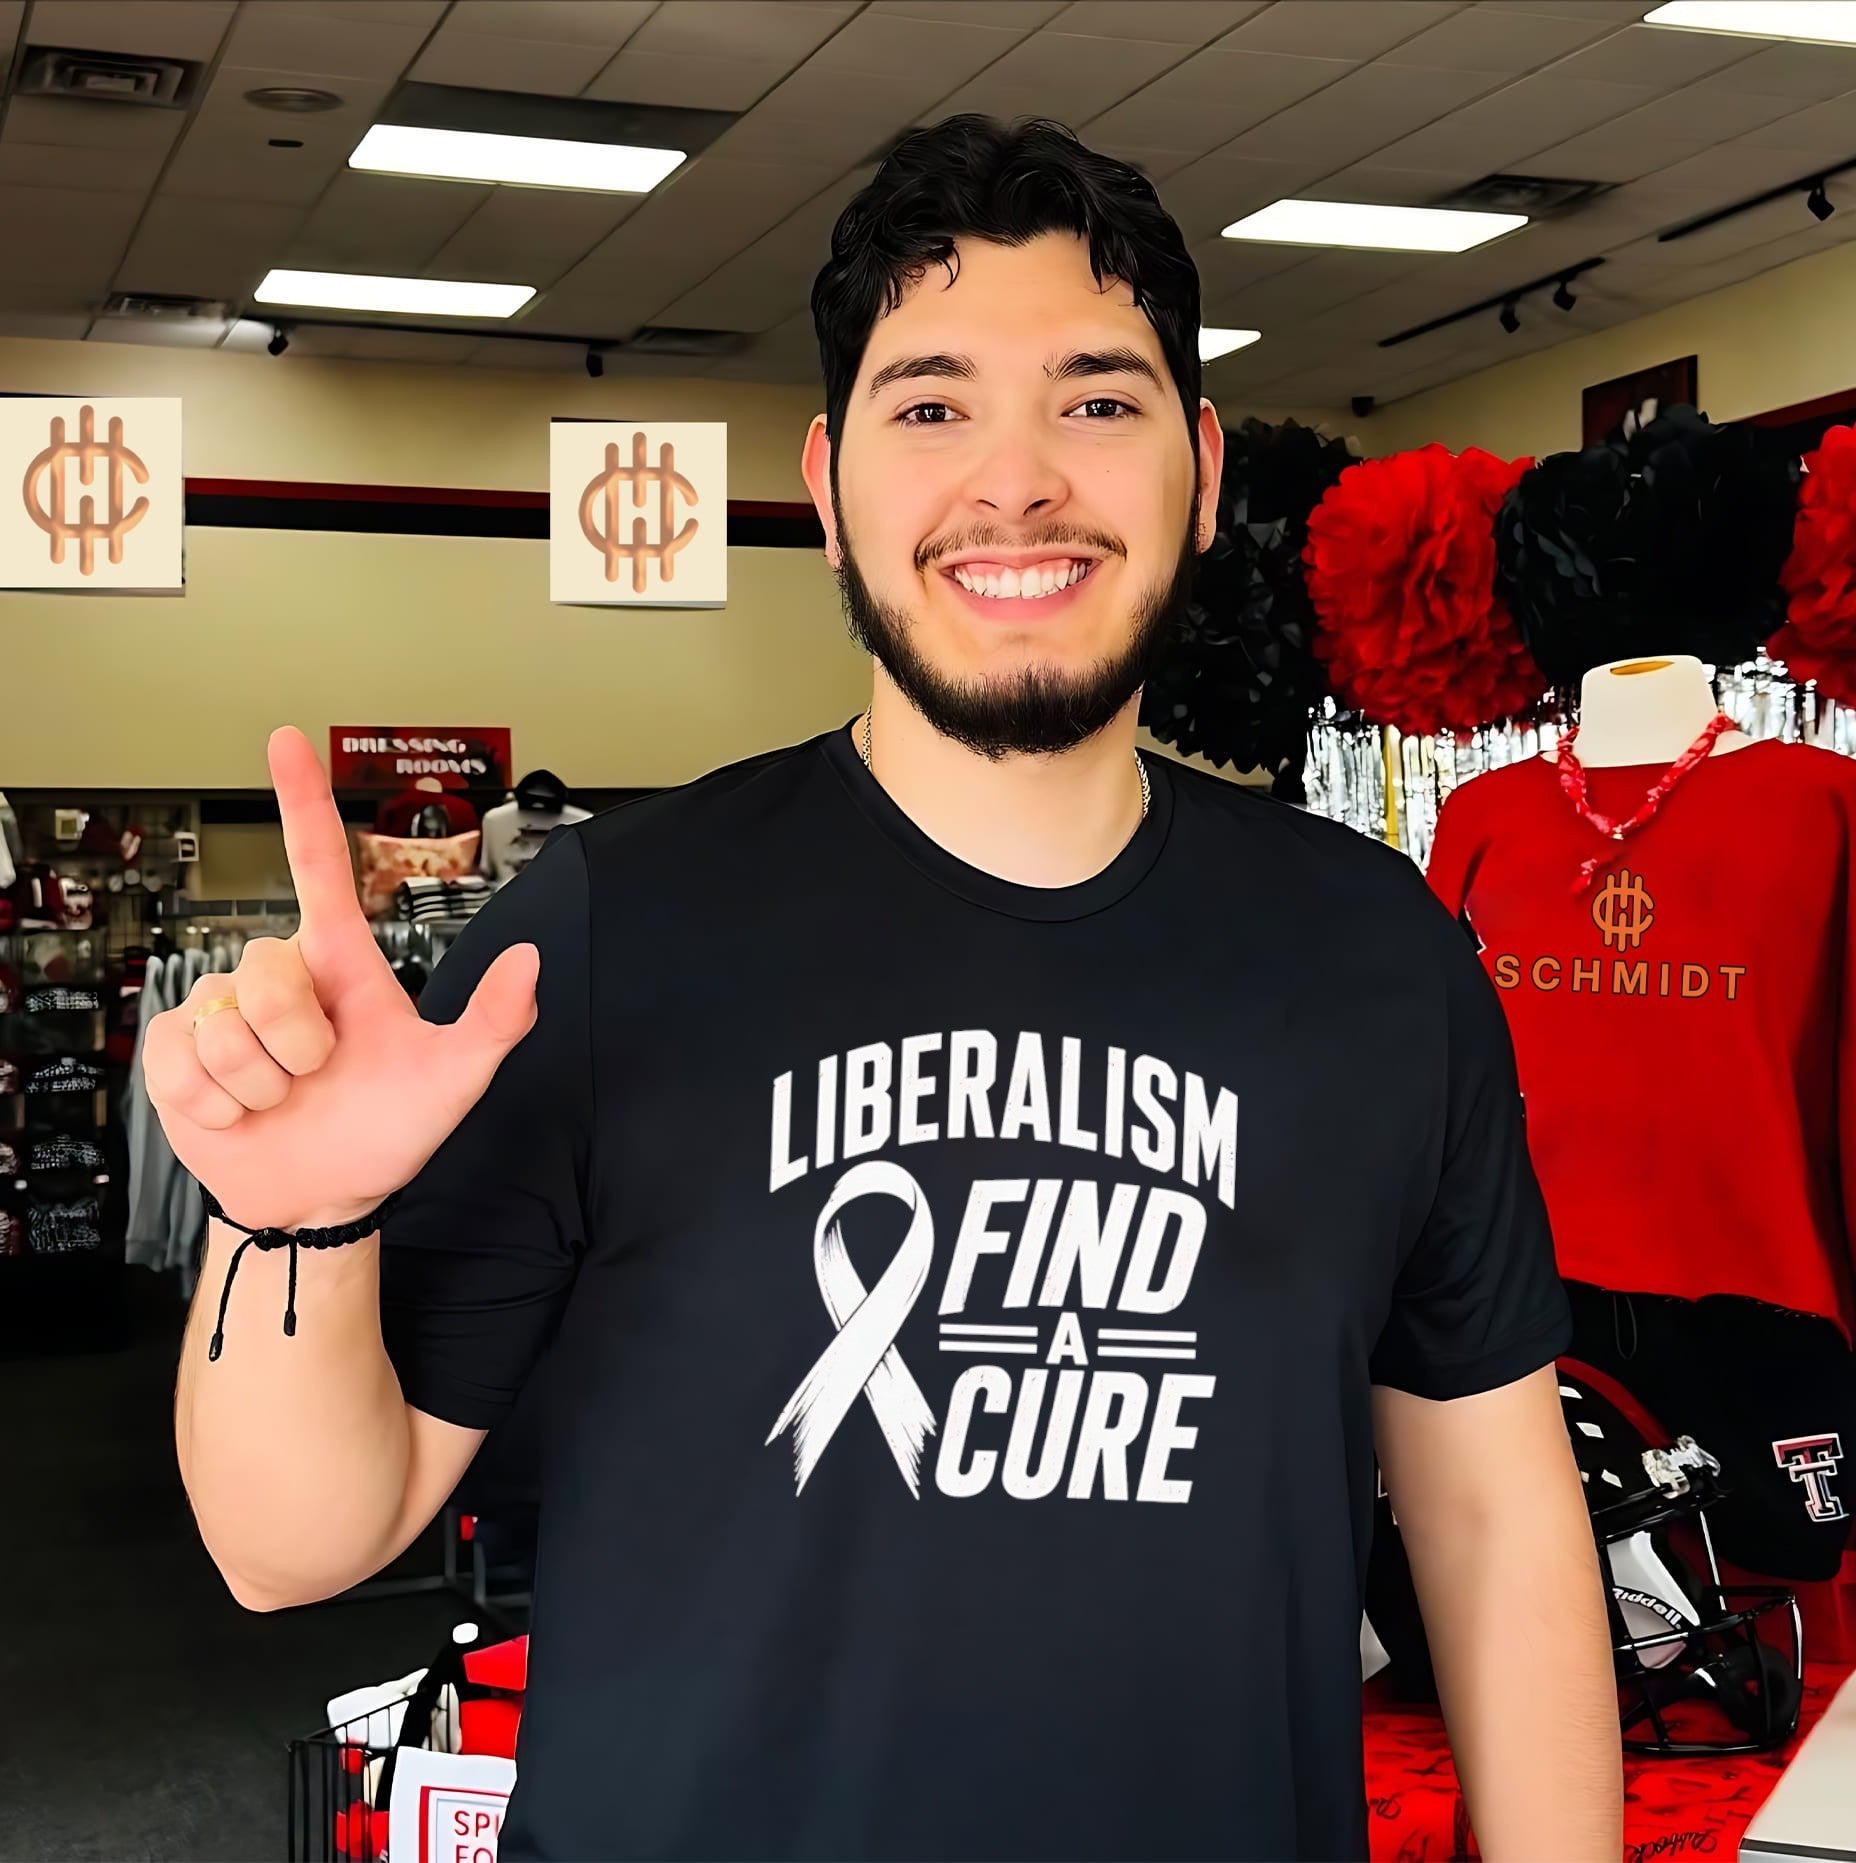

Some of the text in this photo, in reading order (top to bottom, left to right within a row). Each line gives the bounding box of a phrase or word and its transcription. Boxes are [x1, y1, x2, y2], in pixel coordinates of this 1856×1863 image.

[342, 737, 467, 754] DRESSING
[396, 758, 487, 775] ROOMS
[1494, 954, 1747, 1000] SCHMIDT
[769, 1028, 1239, 1211] LIBERALISM
[937, 1178, 1208, 1316] FIND
[1044, 1310, 1090, 1366] A
[934, 1364, 1217, 1504] CURE
